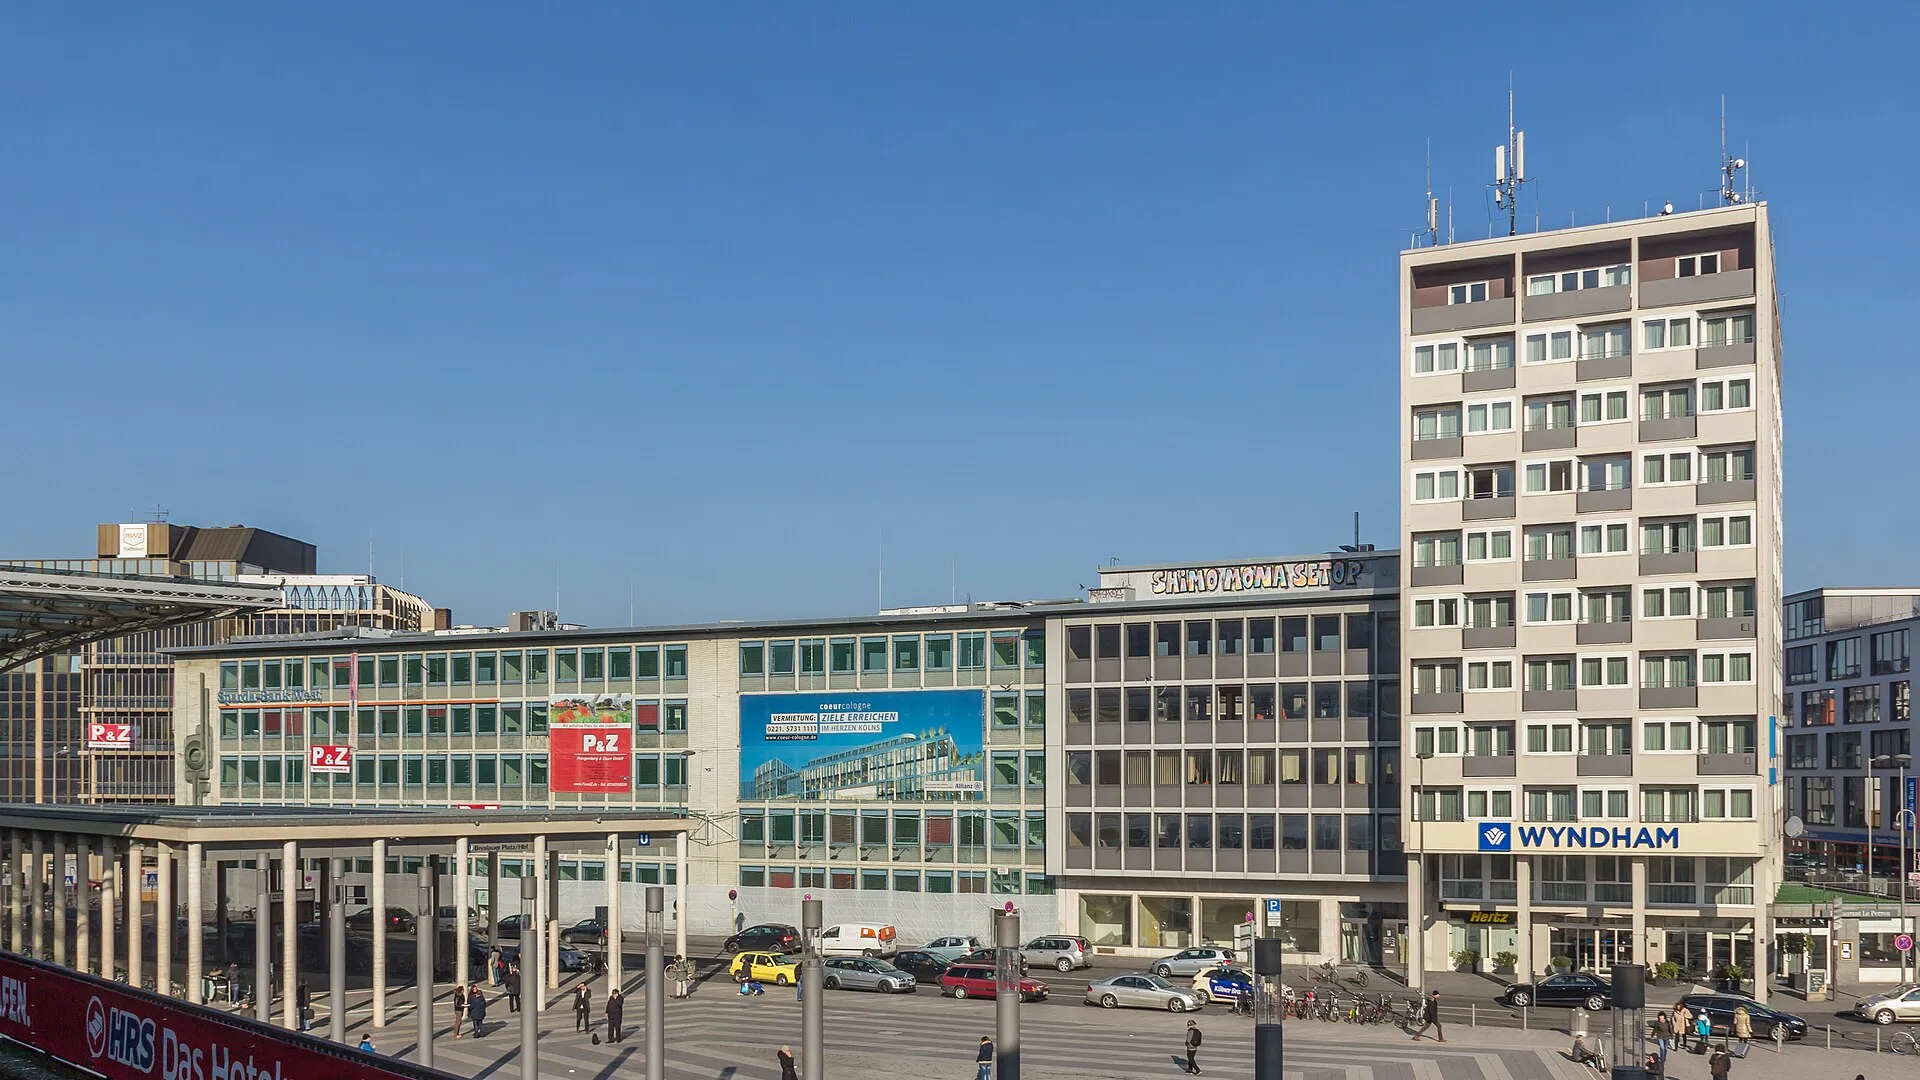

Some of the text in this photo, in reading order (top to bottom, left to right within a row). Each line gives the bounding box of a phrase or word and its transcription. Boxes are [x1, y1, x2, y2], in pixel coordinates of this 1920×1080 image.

[1223, 564, 1288, 592] MONA
[218, 689, 322, 705] Sparda-Bank West
[820, 701, 871, 711] coeurcologne
[821, 712, 897, 722] ZIELE ERREICHEN
[641, 834, 649, 844] U
[1518, 826, 1679, 849] WYNDHAM
[1471, 911, 1508, 922] Hertz
[0, 975, 30, 1027] FEN.
[108, 1006, 156, 1073] HRS
[163, 1027, 204, 1080] Das
